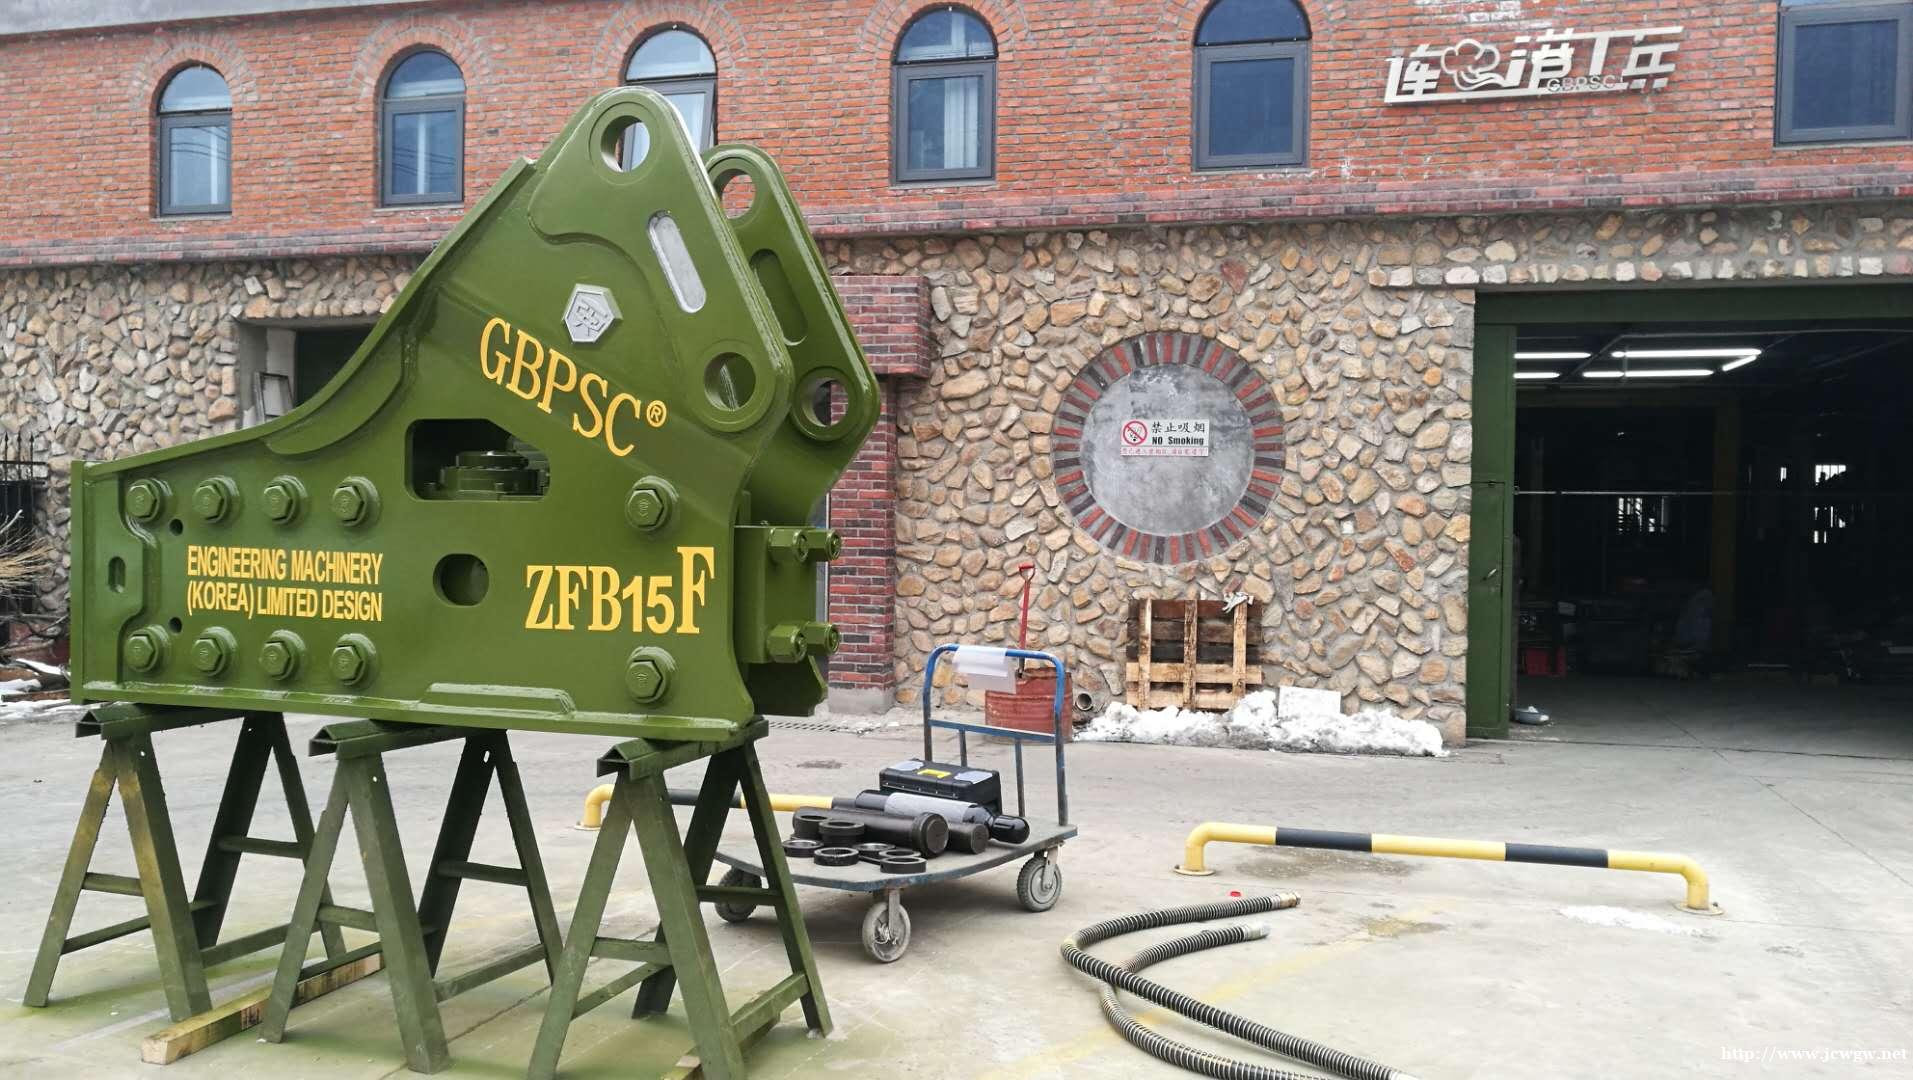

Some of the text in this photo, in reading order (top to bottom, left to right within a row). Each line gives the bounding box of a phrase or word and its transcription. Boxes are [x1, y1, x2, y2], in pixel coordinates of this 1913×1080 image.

[1151, 436, 1204, 445] NO Smoking
[1152, 421, 1205, 433] 禁止吸烟
[187, 545, 383, 584] ENGINEERING MACHINERY
[187, 580, 383, 622] (KOREA) LIMITED DESIGN
[525, 546, 715, 634] ZFB15F
